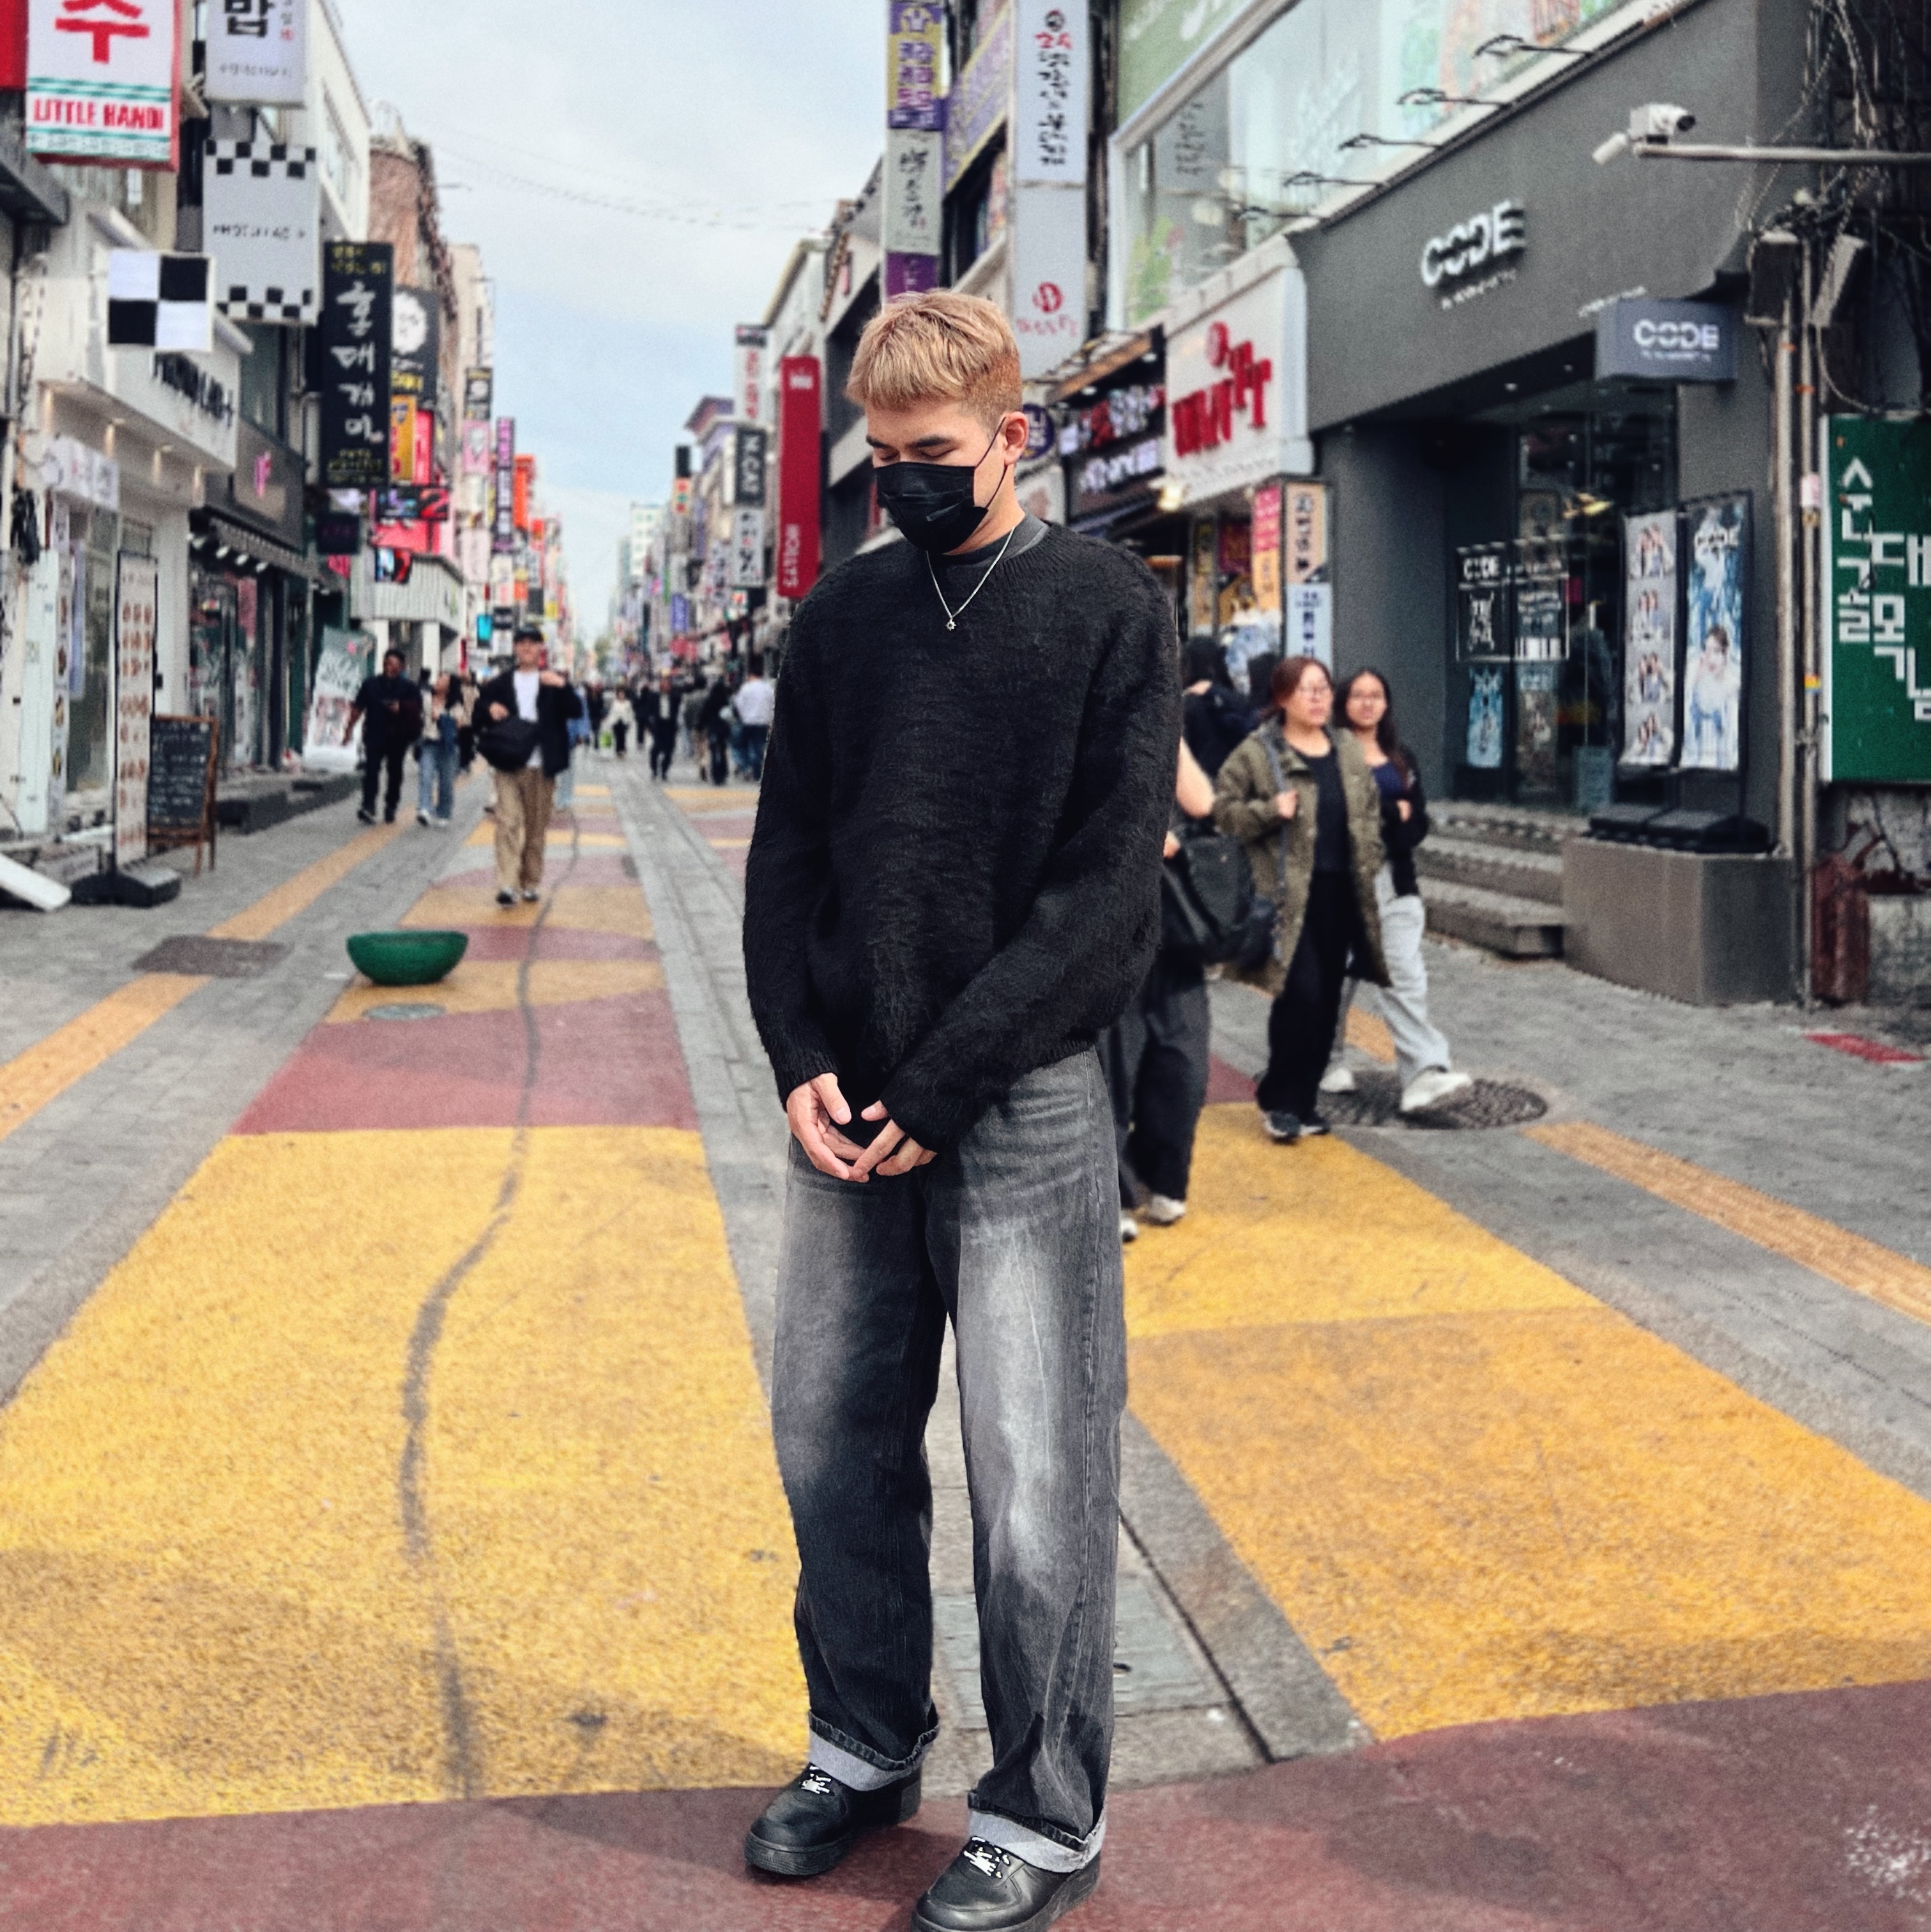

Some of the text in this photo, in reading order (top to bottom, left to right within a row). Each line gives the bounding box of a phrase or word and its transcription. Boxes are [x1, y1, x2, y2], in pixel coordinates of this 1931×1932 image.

[33, 98, 95, 125] LITTLE
[1421, 200, 1525, 286] CODE
[1633, 319, 1720, 351] CODE
